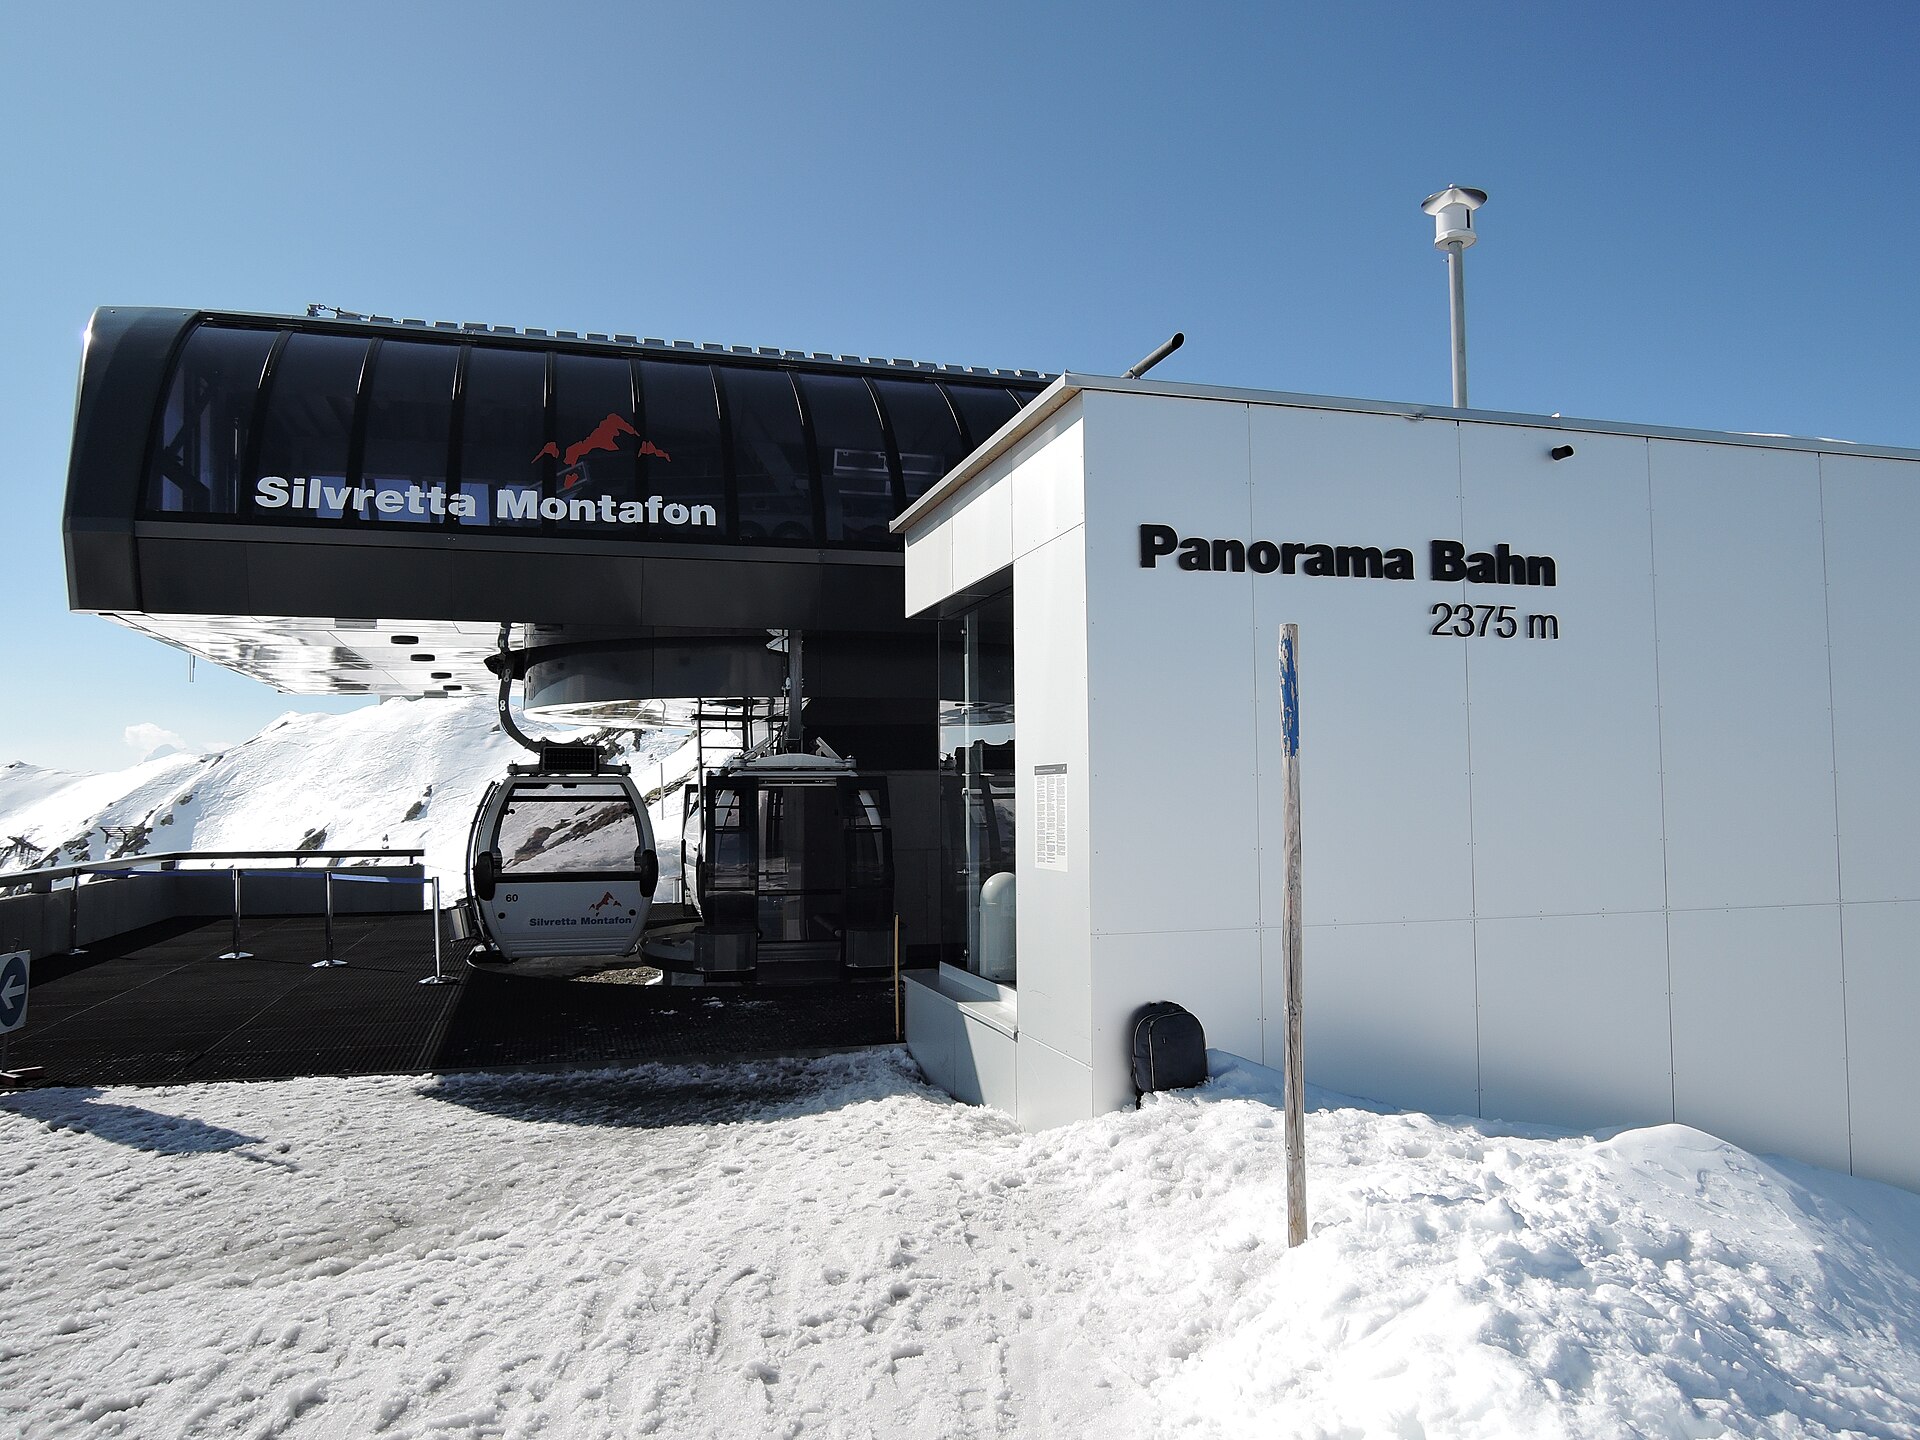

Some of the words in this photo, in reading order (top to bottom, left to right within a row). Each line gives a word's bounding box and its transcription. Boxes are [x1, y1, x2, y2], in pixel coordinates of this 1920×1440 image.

[254, 476, 477, 517] Silvretta
[496, 489, 717, 526] Montafon
[1139, 523, 1415, 580] Panorama
[1430, 539, 1558, 587] Bahn
[1430, 602, 1519, 638] 2375
[1528, 613, 1559, 640] m
[505, 893, 519, 903] 60
[529, 917, 577, 927] Silvretta
[580, 916, 632, 926] Montafon
